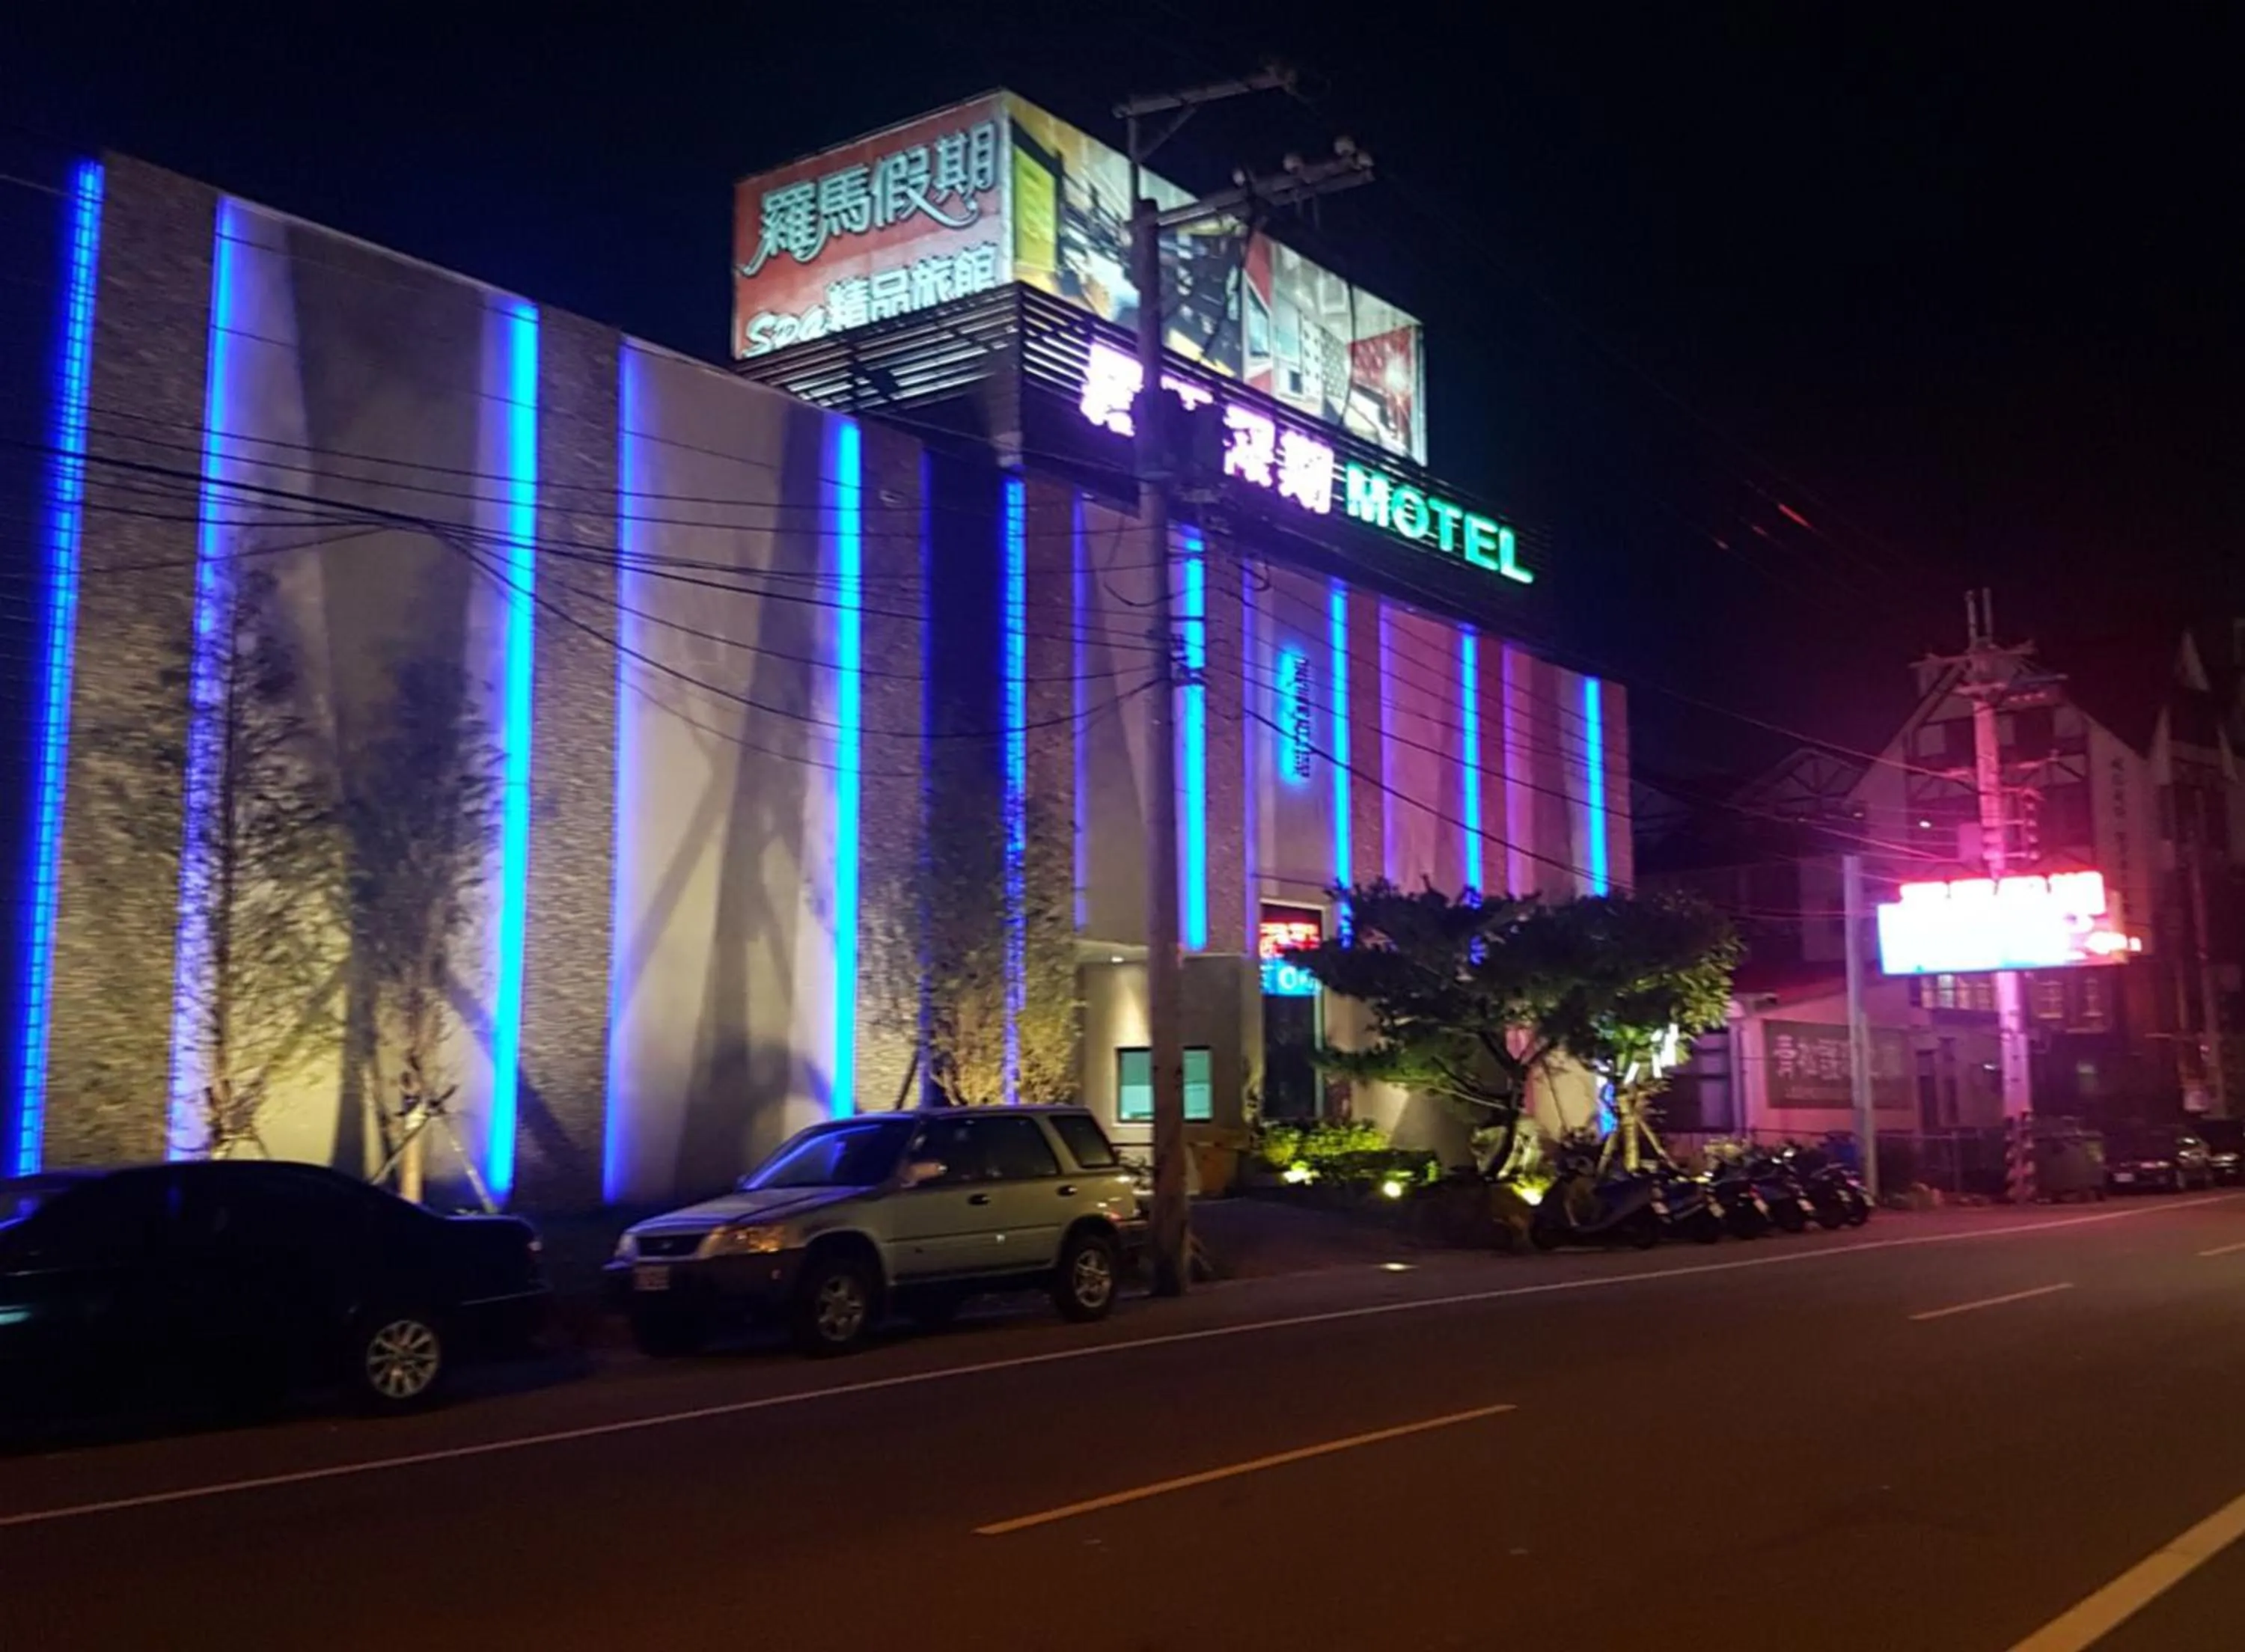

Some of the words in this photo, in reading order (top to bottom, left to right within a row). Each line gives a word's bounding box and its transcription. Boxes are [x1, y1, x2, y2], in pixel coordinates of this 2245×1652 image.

[736, 120, 996, 278] 羅馬假期
[1346, 462, 1533, 584] MOTEL
